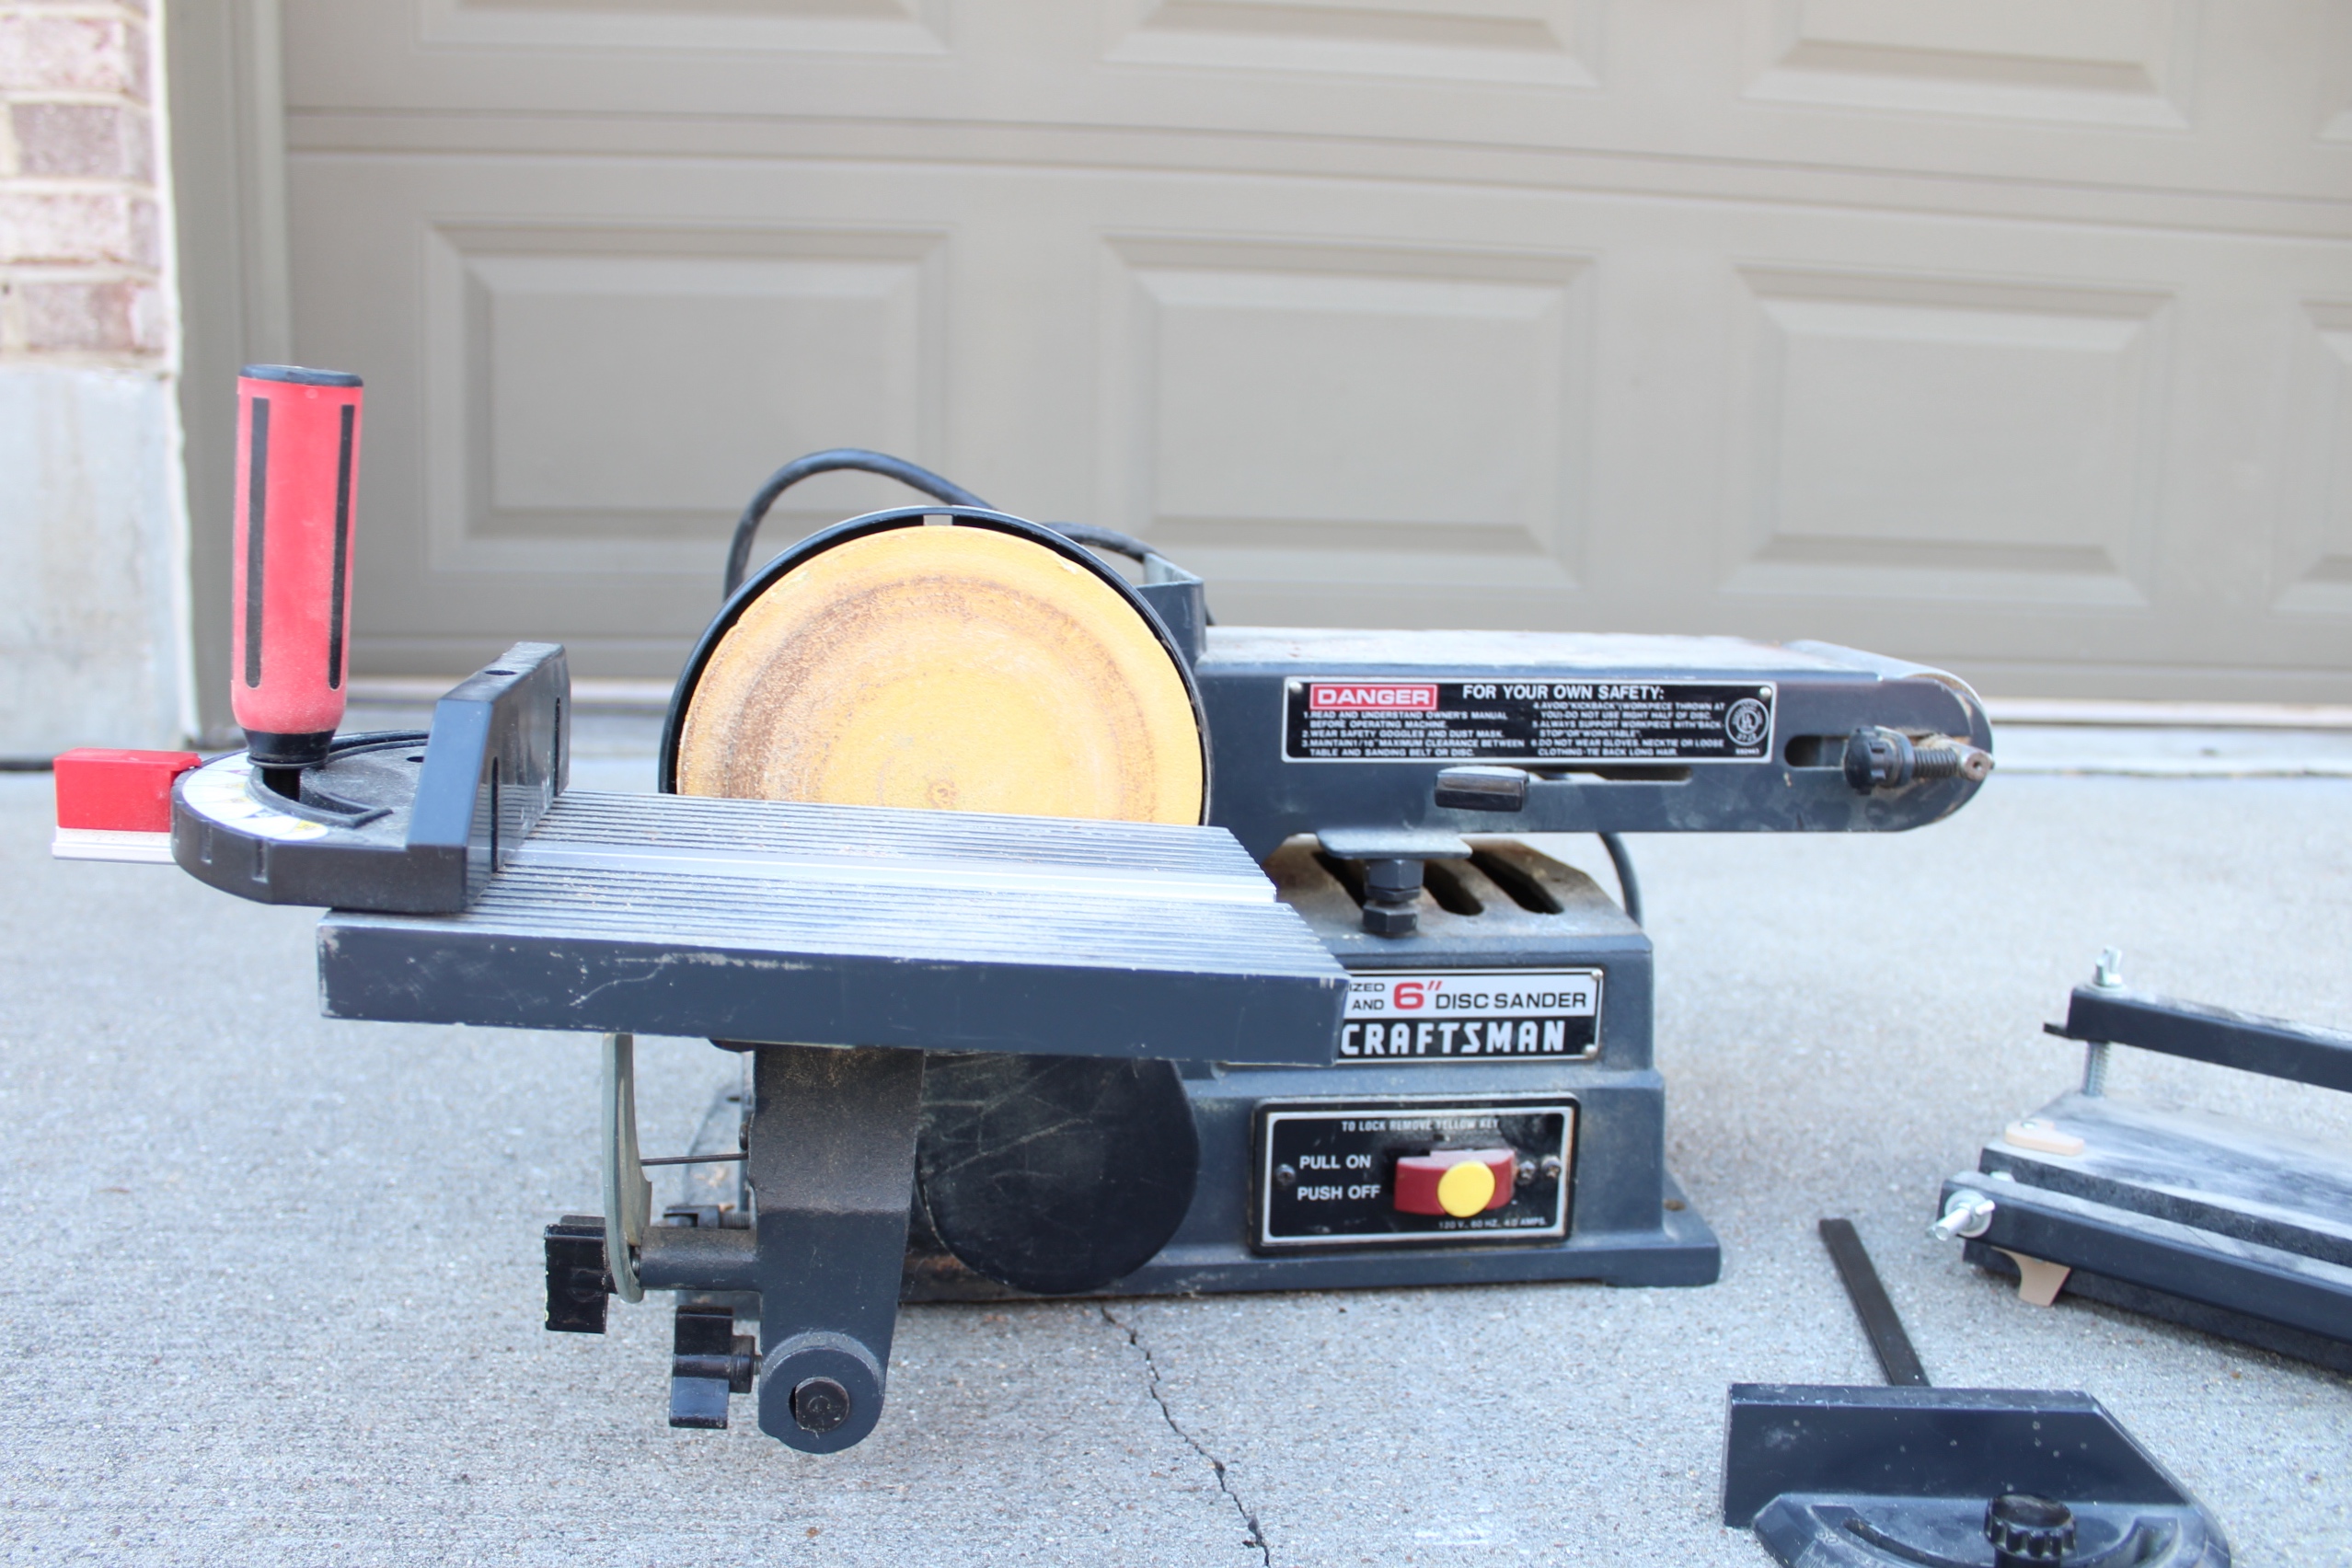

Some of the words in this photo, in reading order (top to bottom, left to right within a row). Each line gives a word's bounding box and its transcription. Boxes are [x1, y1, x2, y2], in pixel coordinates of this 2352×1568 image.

[1317, 688, 1431, 705] DANGER
[1463, 685, 1496, 699] FOR
[1504, 685, 1548, 699] YOUR
[1553, 686, 1595, 700] OWN
[1597, 685, 1665, 700] SAFETY:
[1675, 702, 1712, 711] THROWN
[1713, 702, 1725, 711] AT
[1338, 711, 1359, 720] AND
[1361, 711, 1424, 720] UNDERSTAND
[1425, 711, 1469, 720] OWNER'S
[1470, 711, 1508, 720] MANUAL
[1580, 710, 1599, 720] NOT
[1601, 710, 1620, 720] USE
[1622, 710, 1649, 720] RIGHT
[1650, 711, 1673, 720] HALF
[1675, 711, 1688, 720] OF
[1309, 720, 1346, 729] BEFORE
[1349, 721, 1402, 729] OPERATING
[1404, 721, 1448, 729] MACHINE.
[1578, 720, 1619, 729] SUPPORT
[1620, 720, 1672, 729] WORKPIECE
[1340, 730, 1377, 738] SAFETY
[1378, 730, 1425, 738] GOGGLES
[1427, 730, 1447, 738] AND
[1448, 730, 1474, 738] DUST
[1476, 730, 1505, 738] MASK.
[1424, 739, 1479, 747] CLEARANCE
[1481, 739, 1526, 747] BETWEEN
[1553, 738, 1573, 747] NOT
[1574, 738, 1601, 747] WEAR
[1642, 739, 1679, 748] NECKTIE
[1680, 739, 1693, 748] OR
[1694, 739, 1724, 748] LOOSE
[1309, 748, 1339, 756] TABLE
[1342, 748, 1362, 756] AND
[1365, 748, 1406, 756] SANDING
[1409, 748, 1432, 756] BELT
[1435, 748, 1448, 756] OR
[1450, 748, 1475, 756] DISC.
[1602, 748, 1627, 756] BACK
[1629, 748, 1654, 756] LONG
[1348, 983, 1386, 992] IZED
[1352, 999, 1385, 1010] AND
[1435, 993, 1489, 1009] DISC
[1494, 992, 1586, 1009] SANDER
[1341, 1020, 1565, 1055] CRAFTSMAN
[1342, 1120, 1356, 1132] TO
[1359, 1120, 1386, 1132] LOCK
[1389, 1119, 1433, 1131] REMOVE
[1435, 1118, 1476, 1130] YELLOW
[1479, 1117, 1499, 1129] KEY
[1298, 1155, 1341, 1170] PULL
[1345, 1154, 1371, 1169] ON
[1297, 1186, 1343, 1201] PUSH
[1347, 1184, 1381, 1200] OFF
[1438, 1220, 1457, 1229] 120
